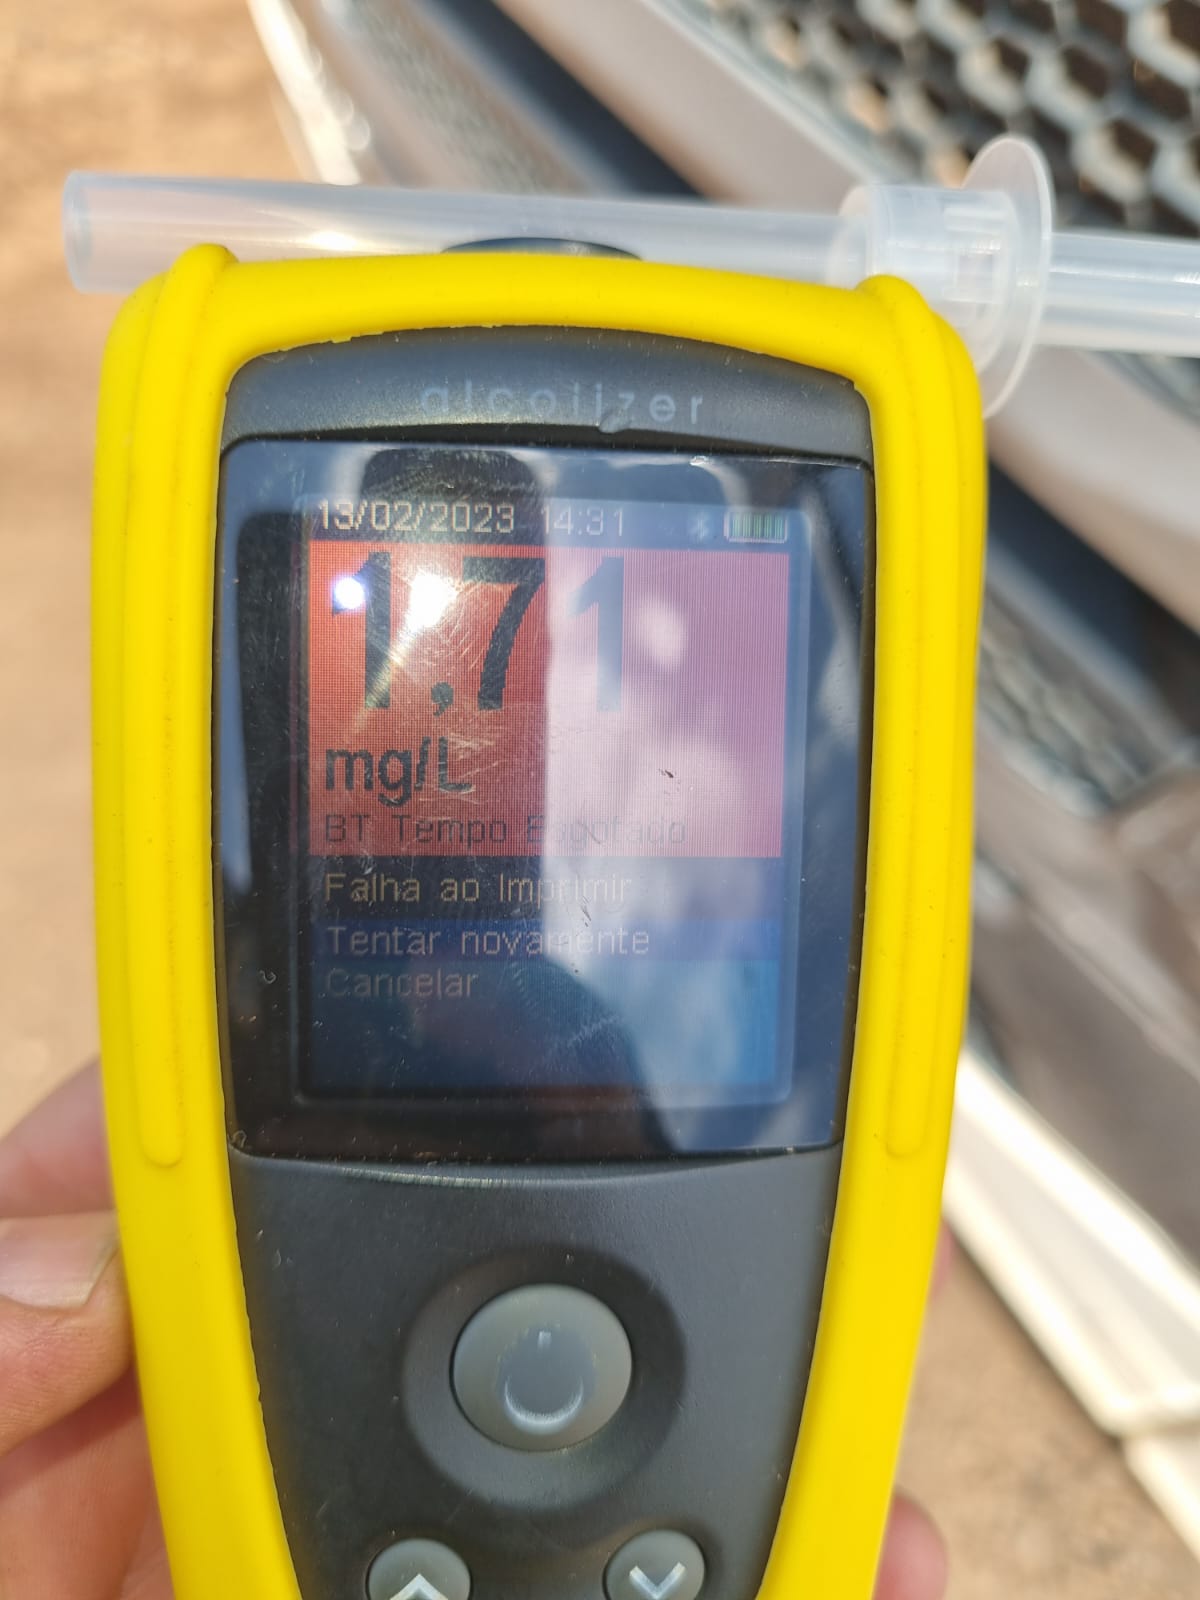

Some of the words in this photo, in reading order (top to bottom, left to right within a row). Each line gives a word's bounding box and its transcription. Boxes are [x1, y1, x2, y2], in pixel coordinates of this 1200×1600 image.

[319, 500, 516, 534] 13/02/2023
[541, 504, 626, 538] 14:31
[325, 736, 473, 806] mg/L
[325, 814, 370, 843] BT
[392, 814, 508, 848] Tempo
[325, 873, 421, 904] Falha
[440, 876, 481, 903] ao
[500, 874, 633, 907] Imprimir
[327, 926, 441, 956] Tentar
[460, 928, 650, 955] novamente
[325, 968, 478, 999] Cancelar
